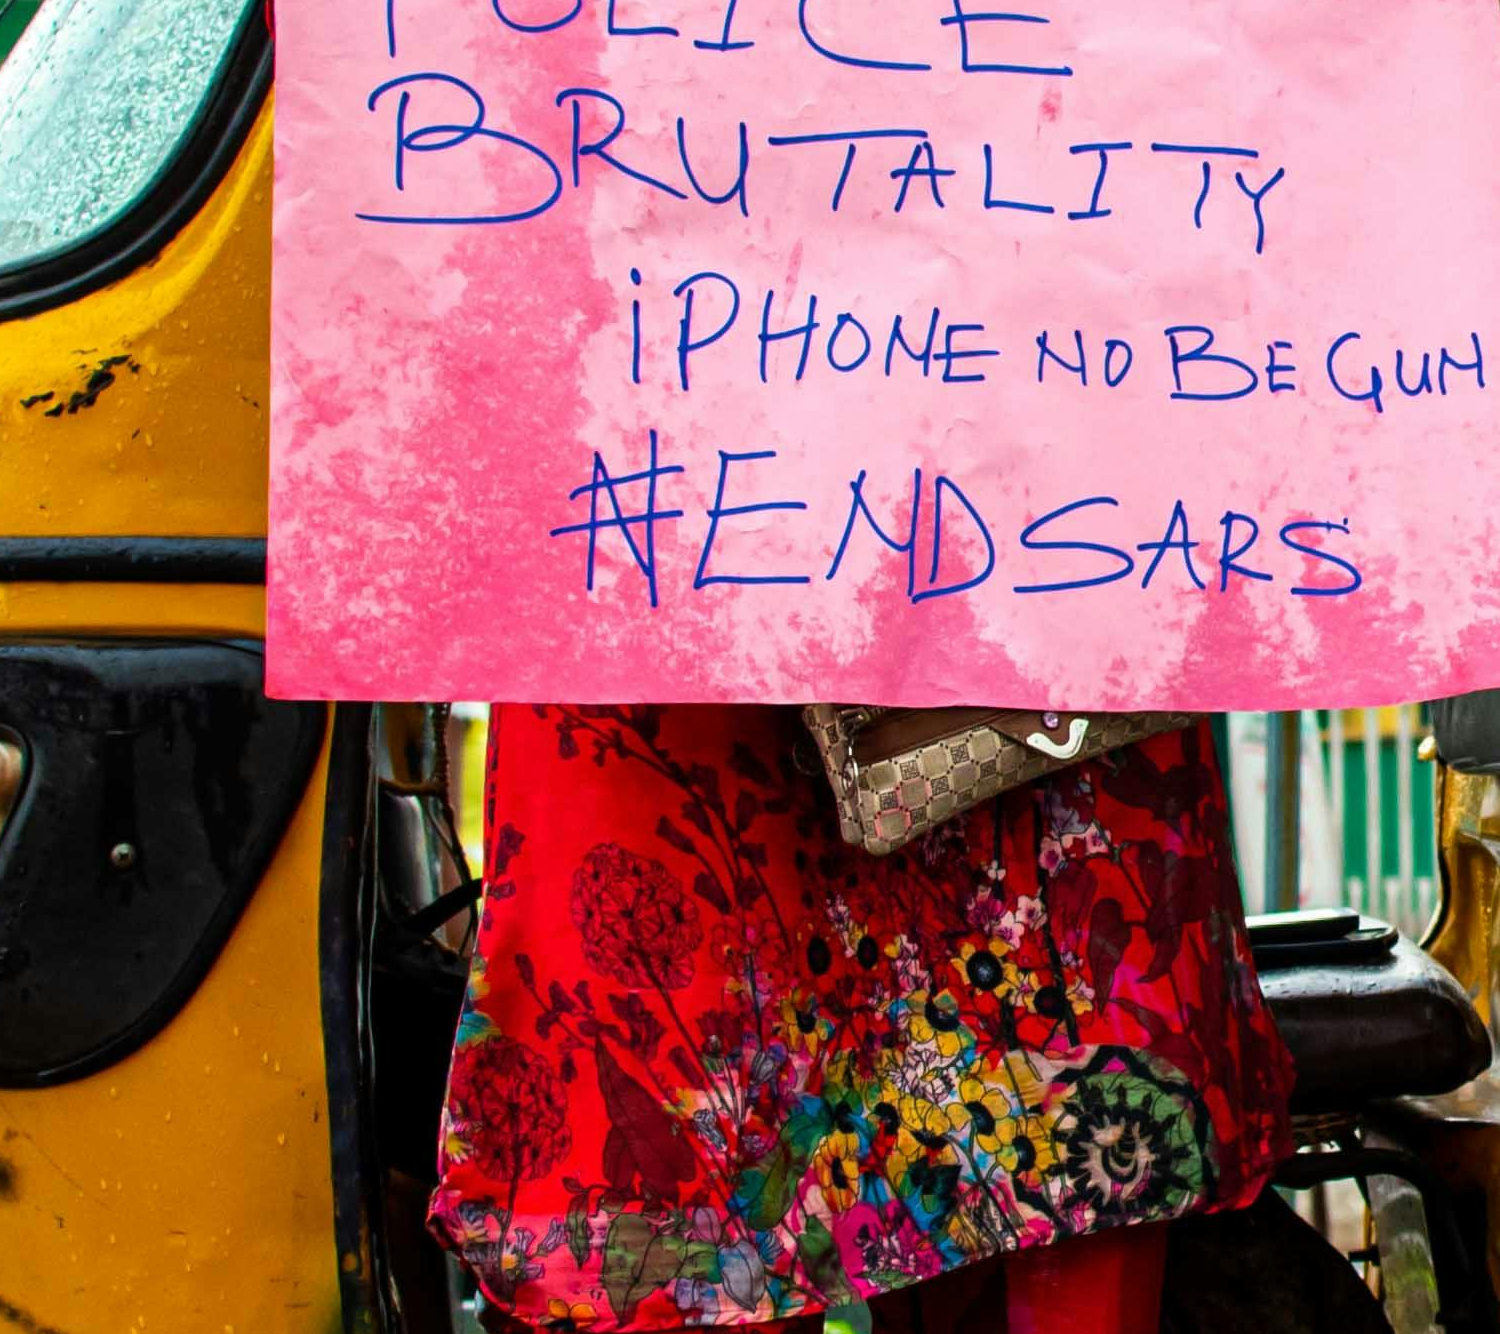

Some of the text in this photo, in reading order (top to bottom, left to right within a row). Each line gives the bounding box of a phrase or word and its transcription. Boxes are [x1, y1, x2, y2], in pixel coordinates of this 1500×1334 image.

[356, 73, 1284, 254] BRUTALITY
[1036, 330, 1132, 387] NO
[1164, 326, 1300, 400] BE
[1327, 332, 1485, 412] GUN
[550, 429, 1361, 607] #ENDSARS
